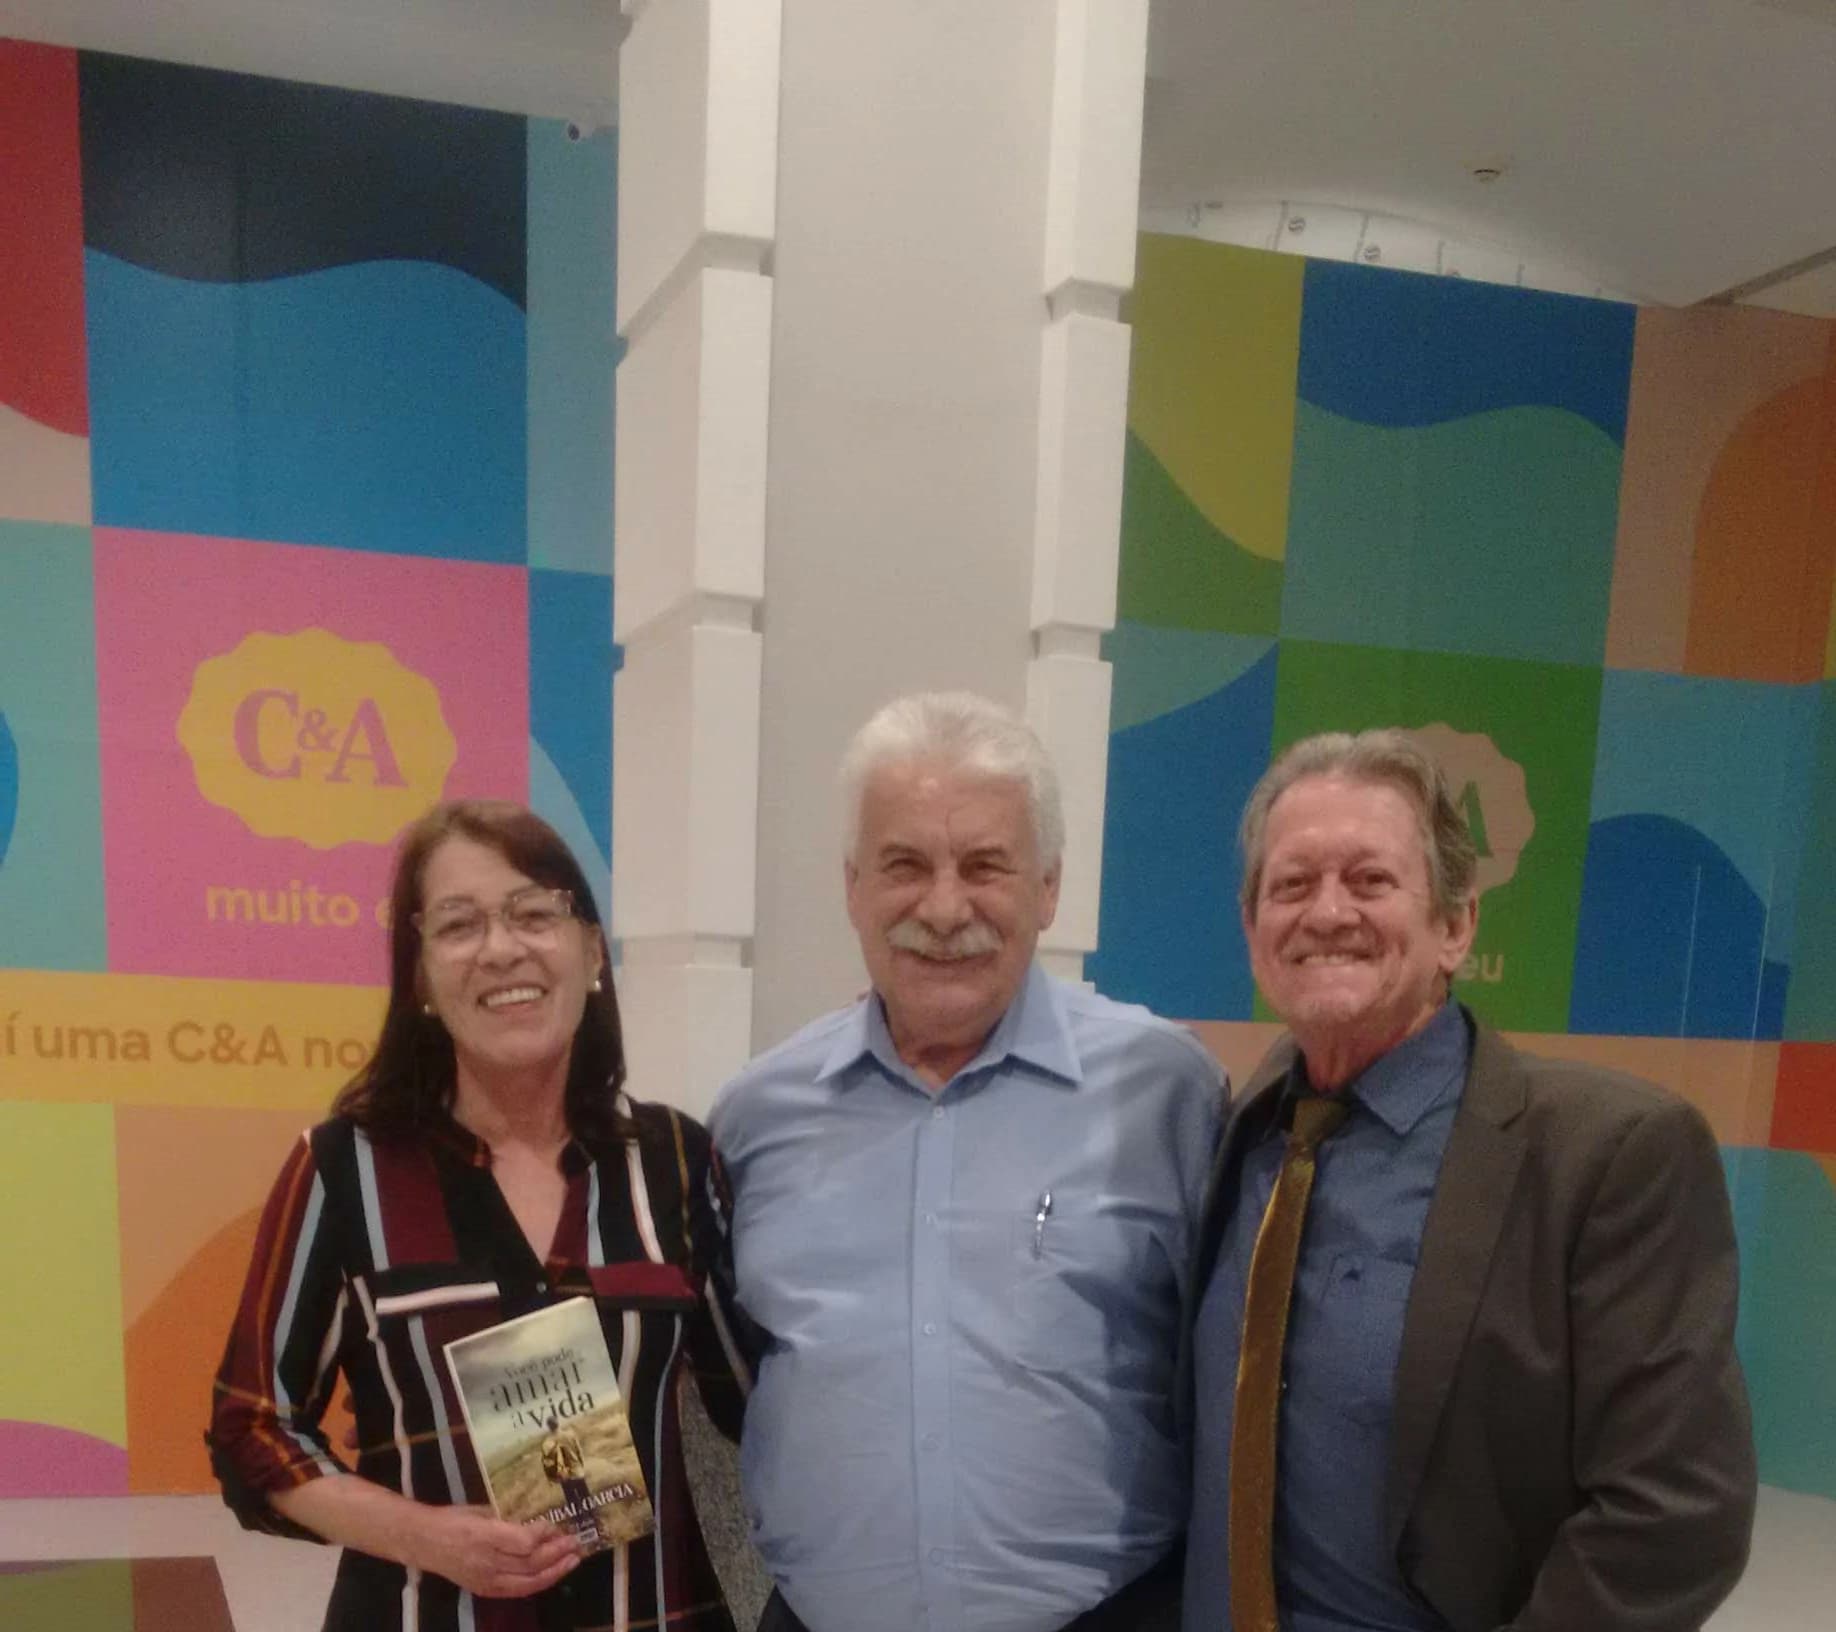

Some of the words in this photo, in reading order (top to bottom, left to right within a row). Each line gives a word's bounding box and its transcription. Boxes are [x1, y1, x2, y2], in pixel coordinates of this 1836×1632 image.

[233, 688, 409, 788] C&A
[206, 880, 360, 928] muito
[33, 1025, 152, 1063] uma
[166, 1021, 289, 1067] C&A
[527, 1390, 594, 1429] vida
